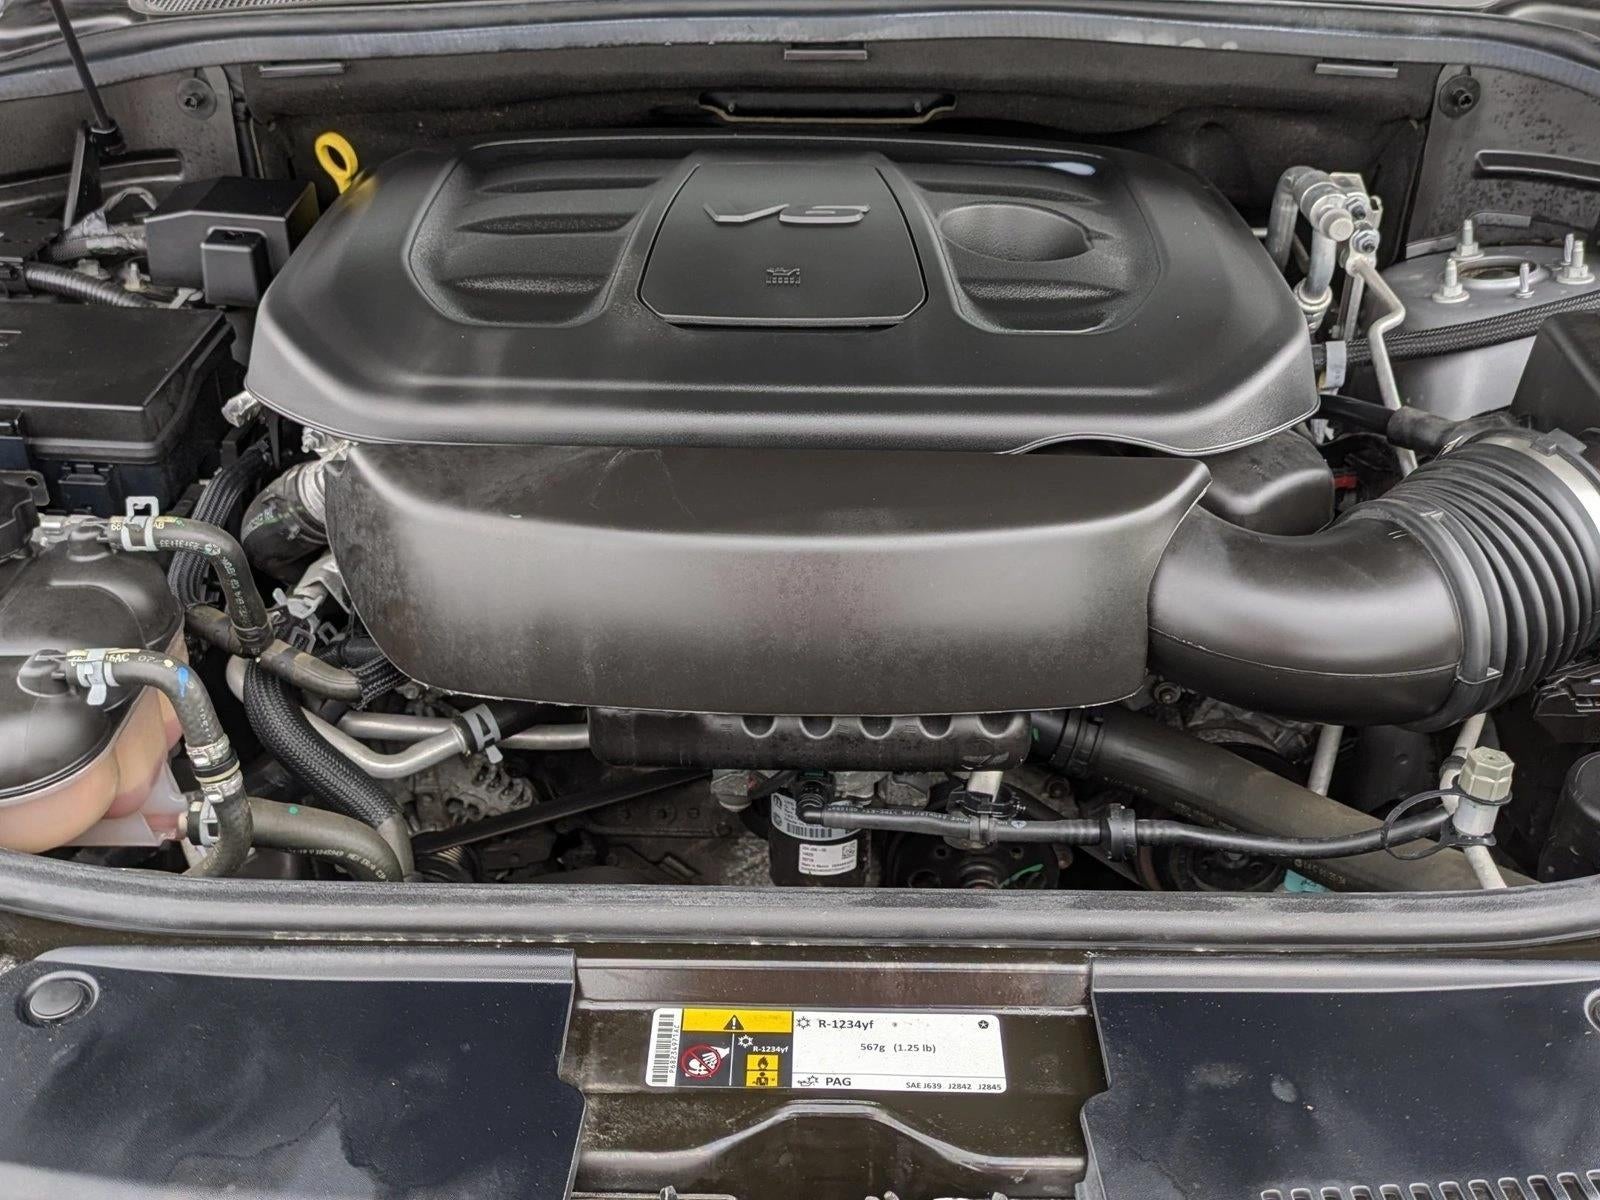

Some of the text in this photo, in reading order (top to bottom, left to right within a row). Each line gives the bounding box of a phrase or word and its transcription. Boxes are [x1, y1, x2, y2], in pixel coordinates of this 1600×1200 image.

[818, 1019, 874, 1031] R-1234yf
[752, 1045, 789, 1054] R-1234yf
[860, 1042, 936, 1054] 567g (1.25 lb)
[825, 1077, 852, 1087] PAG
[905, 1081, 922, 1090] SAE
[923, 1082, 943, 1090] J639
[977, 1083, 1002, 1091] J2845
